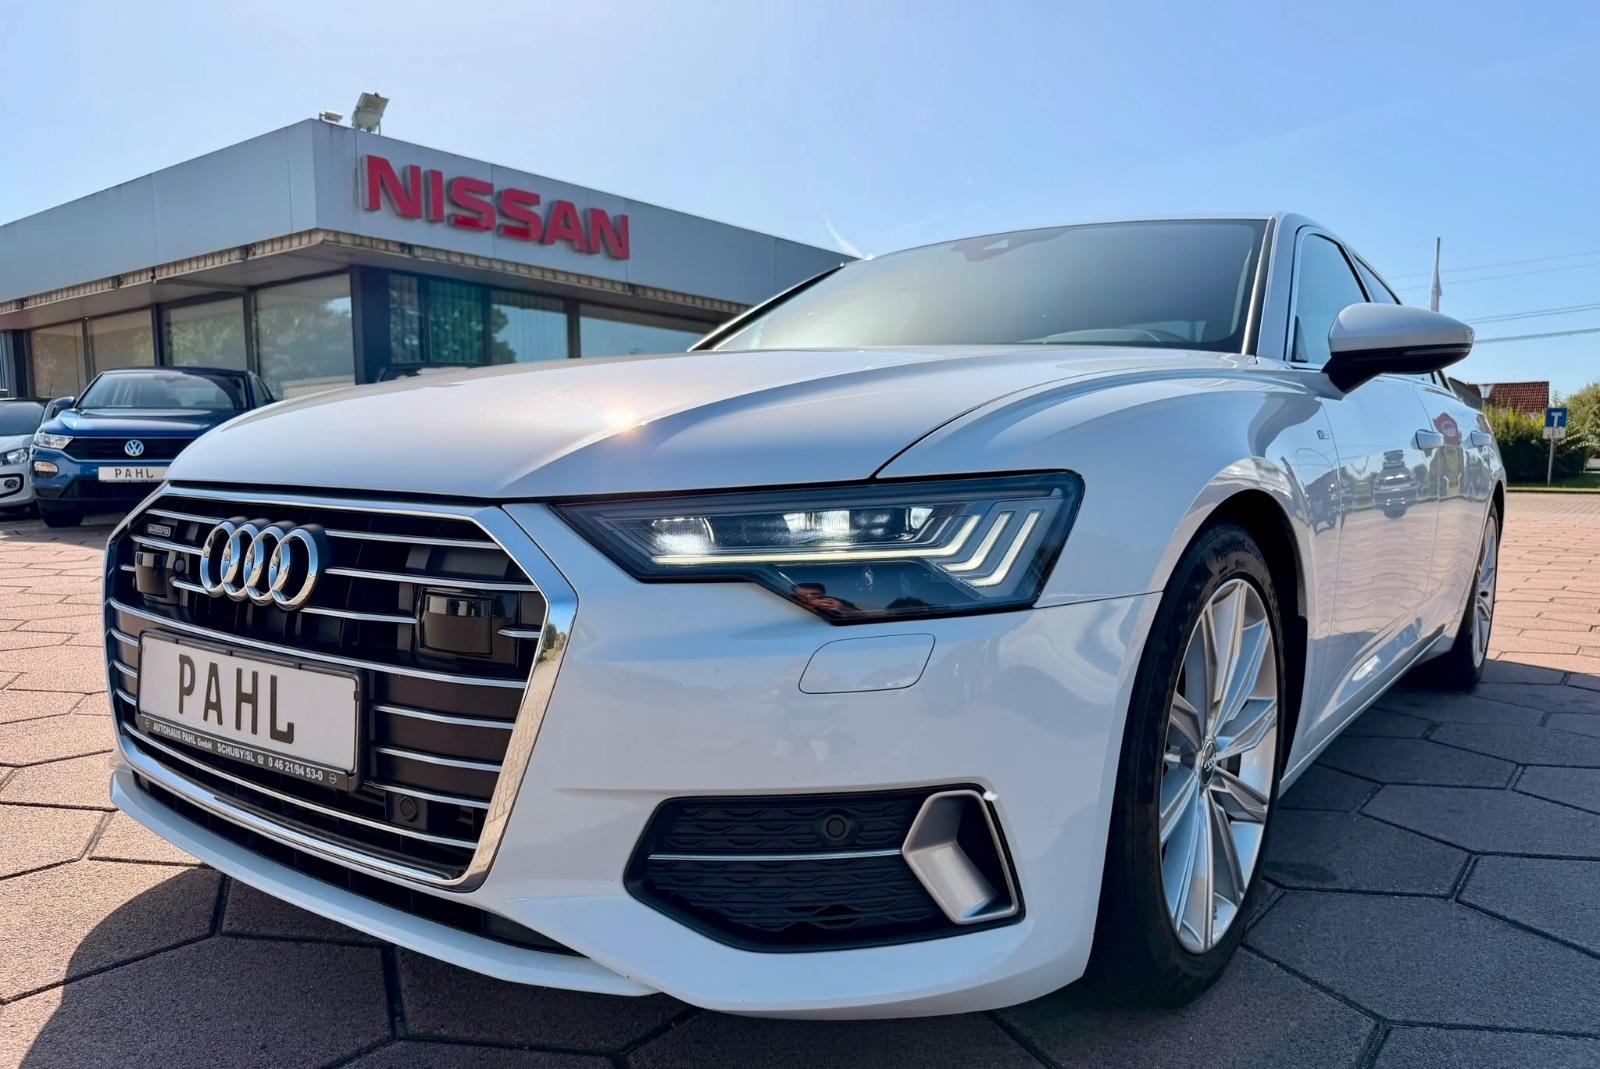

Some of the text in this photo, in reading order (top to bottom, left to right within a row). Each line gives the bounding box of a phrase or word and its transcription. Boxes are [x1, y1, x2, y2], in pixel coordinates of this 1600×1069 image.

[361, 154, 630, 260] NISSAN
[114, 468, 154, 478] PAHL
[178, 653, 295, 744] PAHL
[152, 722, 181, 739] AUTOHAUS
[181, 731, 196, 744] PAHL
[197, 738, 213, 750] GmbH
[217, 743, 255, 762] SCHUBY/SL
